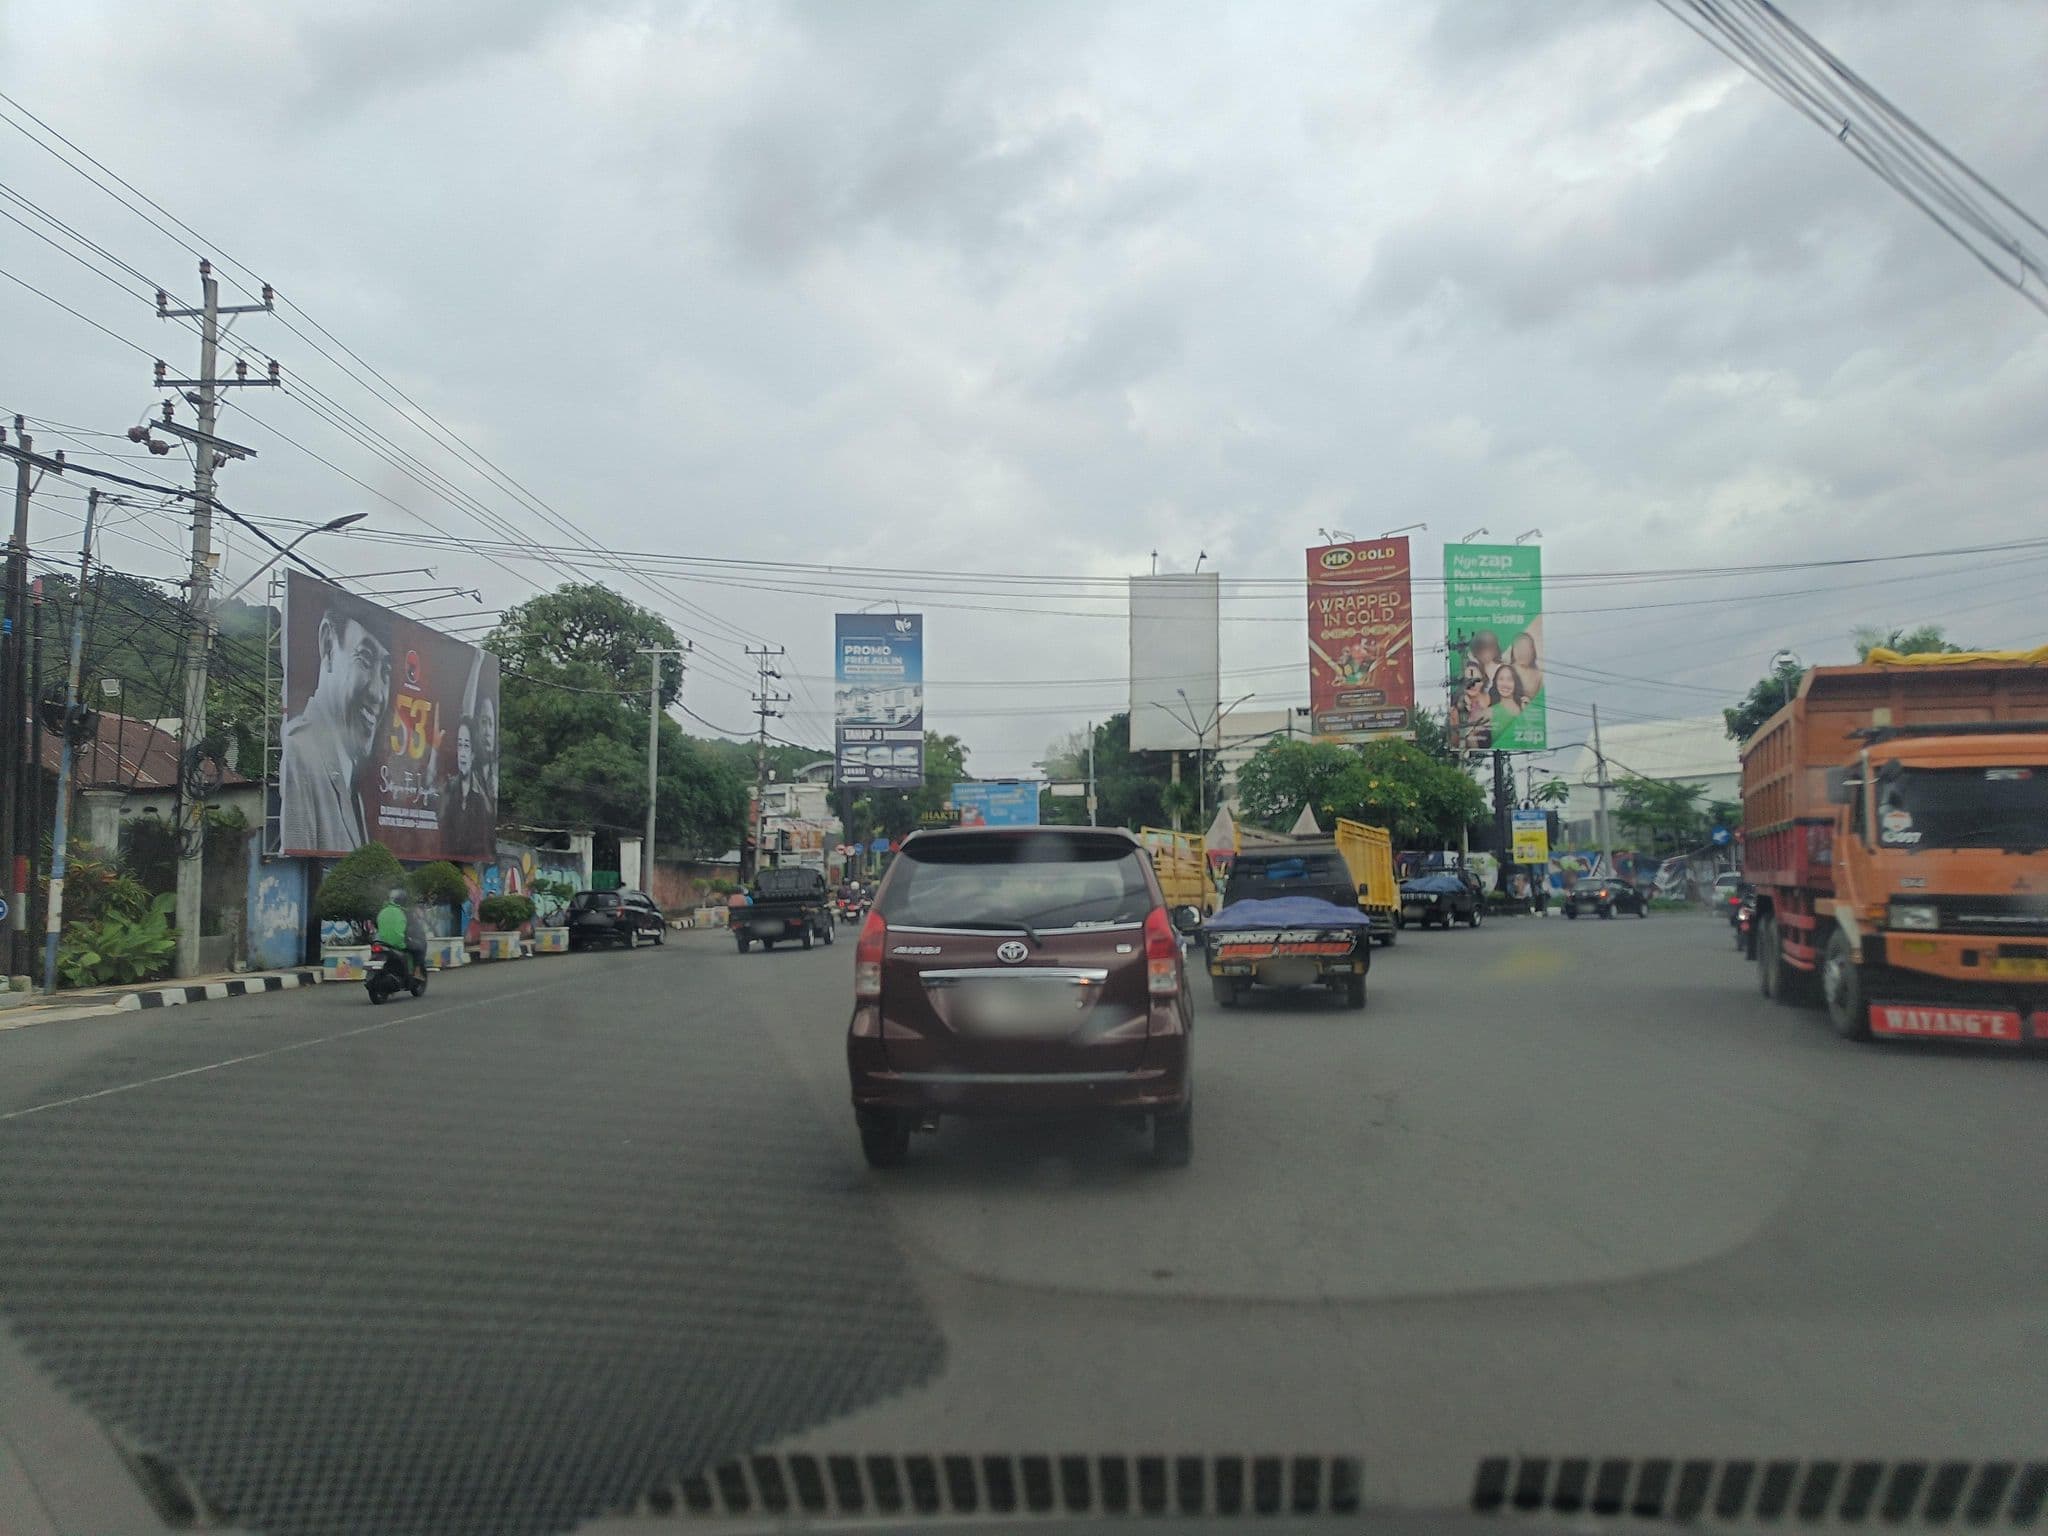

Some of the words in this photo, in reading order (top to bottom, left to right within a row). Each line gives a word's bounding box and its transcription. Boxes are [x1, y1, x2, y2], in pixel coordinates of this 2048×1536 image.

[1357, 547, 1395, 561] GOLD
[1317, 592, 1401, 613] WRAPPED
[1323, 613, 1340, 627] IN
[1346, 608, 1395, 626] GOLD
[844, 645, 892, 655] PROMO
